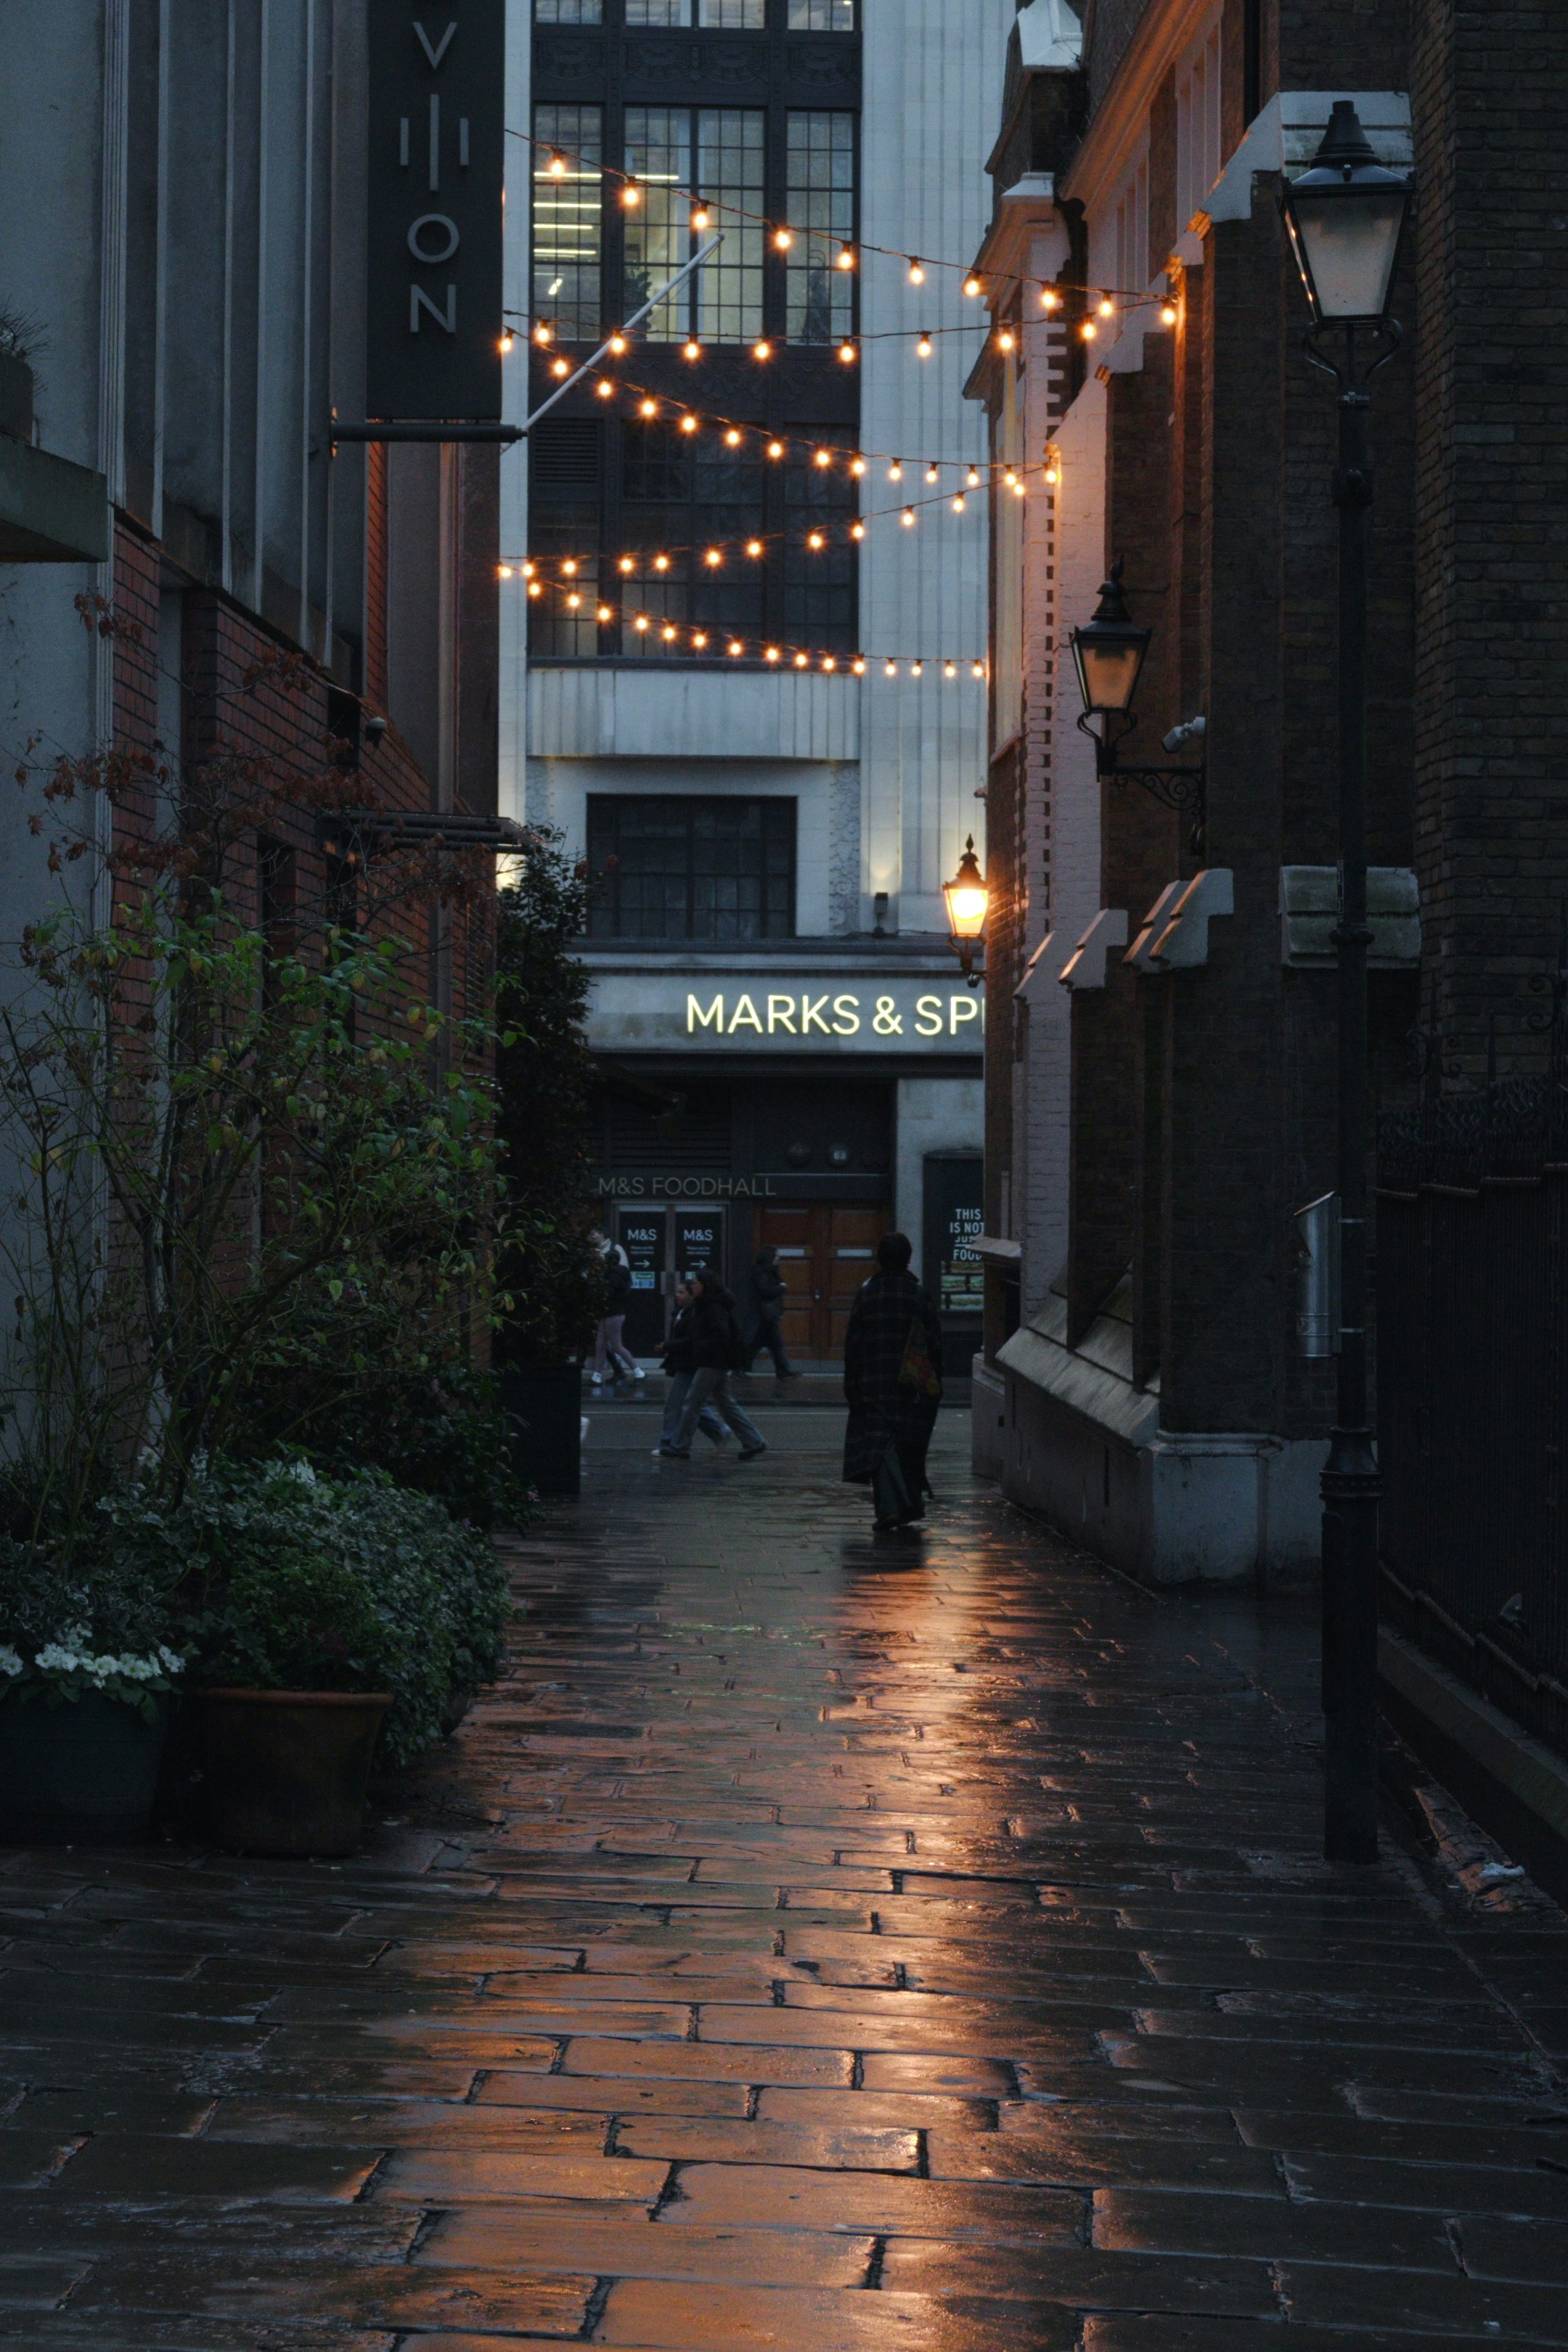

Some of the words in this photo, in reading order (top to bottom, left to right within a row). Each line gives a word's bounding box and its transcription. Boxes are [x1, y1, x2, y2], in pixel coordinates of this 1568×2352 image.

[686, 994, 860, 1036] MARKS
[871, 995, 904, 1036] &
[914, 995, 984, 1037] SP
[598, 1177, 645, 1196] M&S
[653, 1177, 777, 1196] FOODHALL
[955, 1208, 982, 1220] THIS
[950, 1222, 961, 1233] IS
[964, 1222, 985, 1233] NOT
[627, 1228, 658, 1241] M&S
[683, 1228, 714, 1241] M&S
